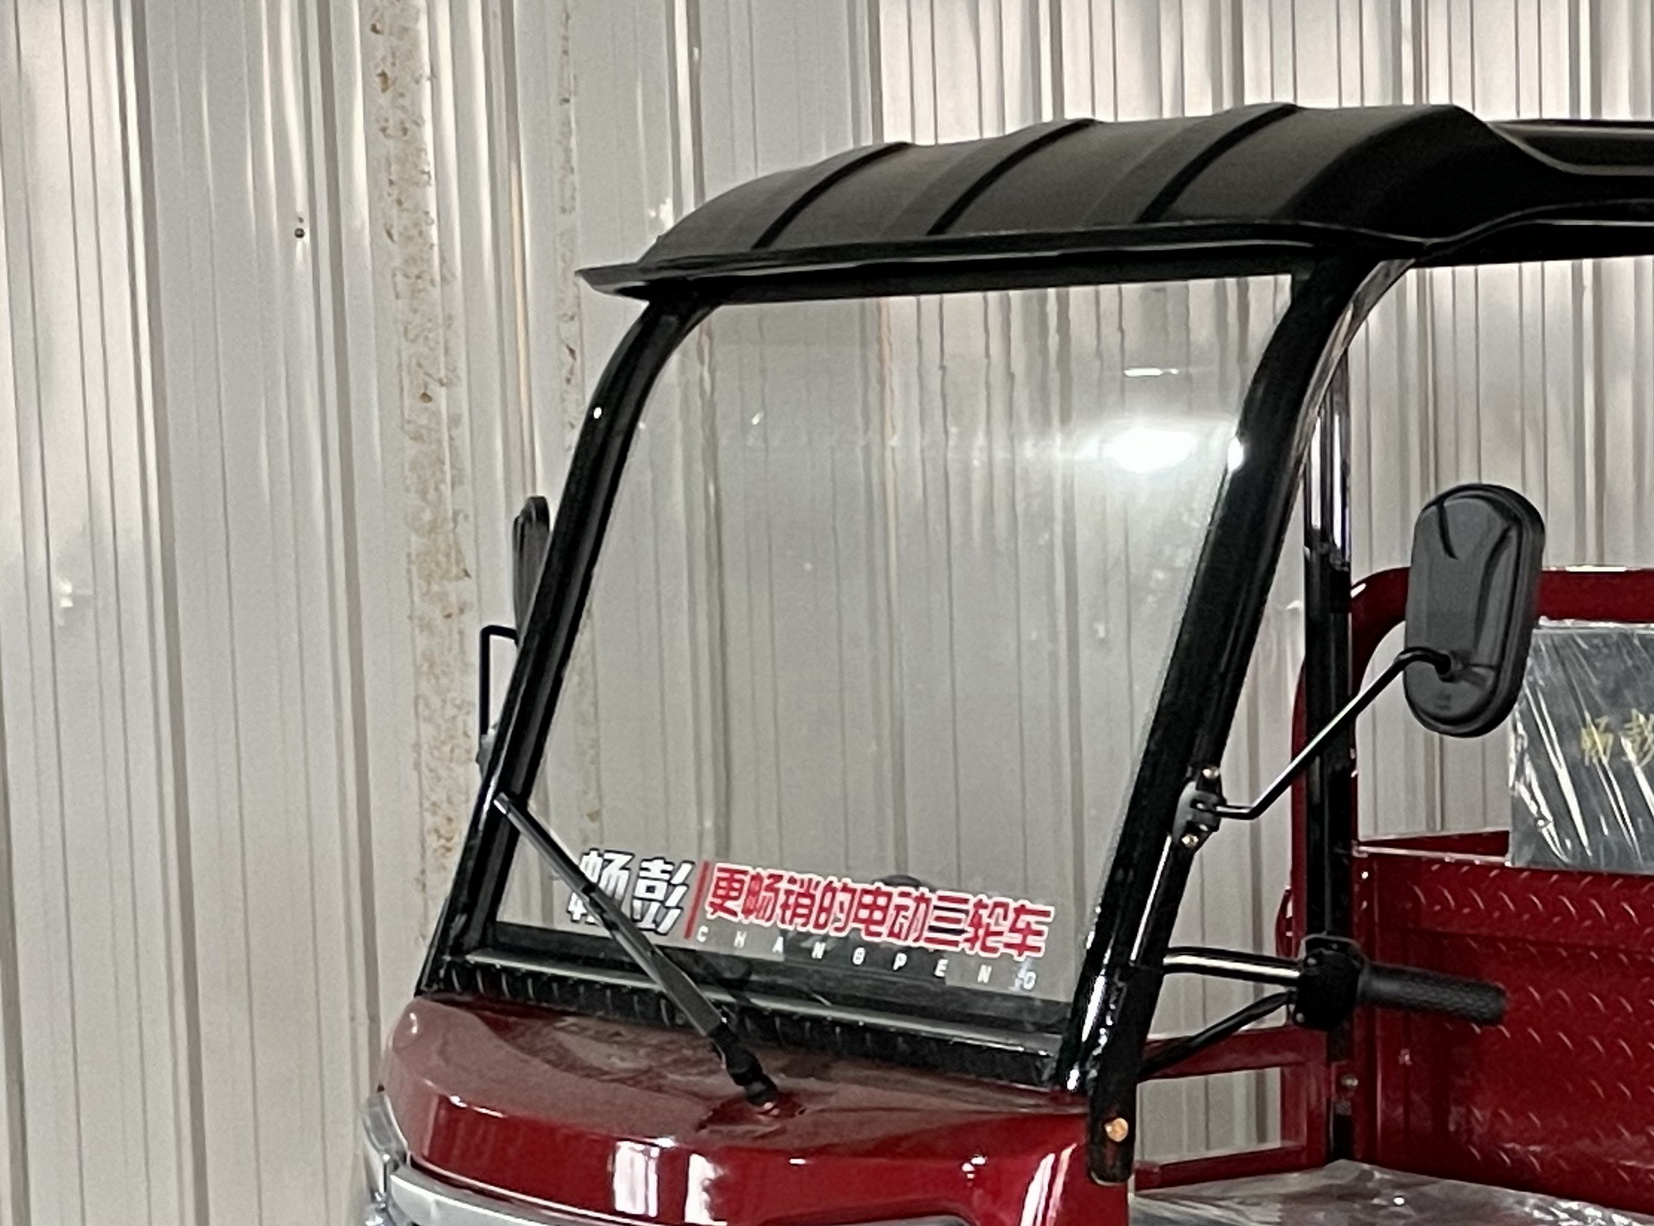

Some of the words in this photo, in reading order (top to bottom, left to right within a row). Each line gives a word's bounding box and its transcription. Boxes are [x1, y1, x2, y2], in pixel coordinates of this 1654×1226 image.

[705, 863, 1056, 961] 更畅销的电动三轮车
